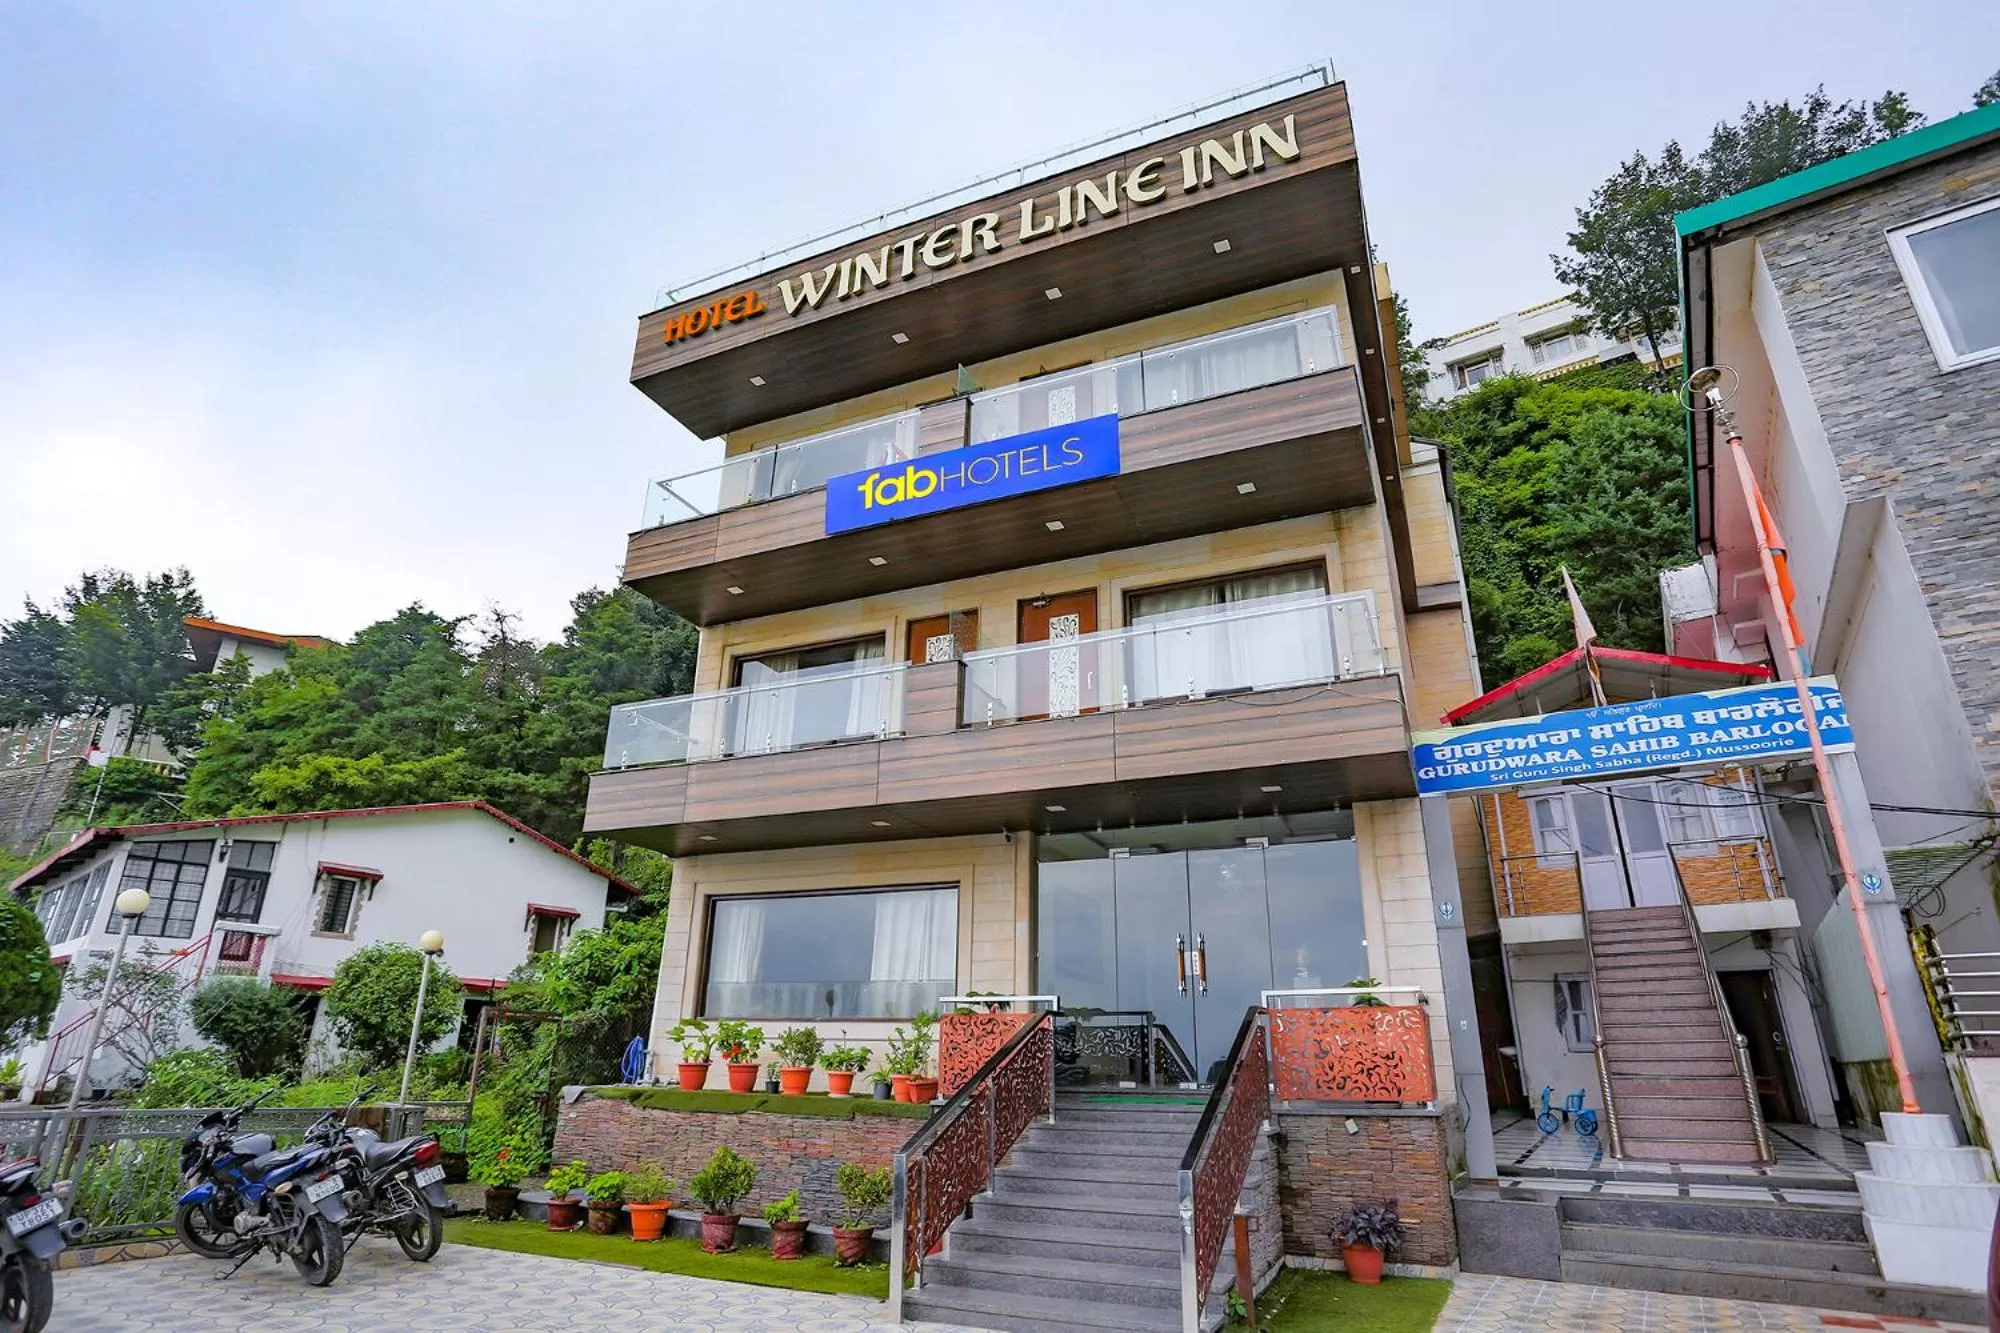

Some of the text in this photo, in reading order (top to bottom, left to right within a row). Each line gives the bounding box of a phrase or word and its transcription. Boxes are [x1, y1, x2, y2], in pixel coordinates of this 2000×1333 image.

[664, 114, 1300, 345] HOTEL WINTER LINE INN
[1418, 748, 1583, 781] GURUDWARA
[1590, 736, 1680, 759] SAHIB
[1432, 728, 1581, 764] ਗੁਰਦੁਆਰਾ
[1588, 714, 1685, 739] ਸਾਹਿਬ
[1490, 738, 1795, 782] Sri Guru Singh Sabha (Regd.) Mussoorie
